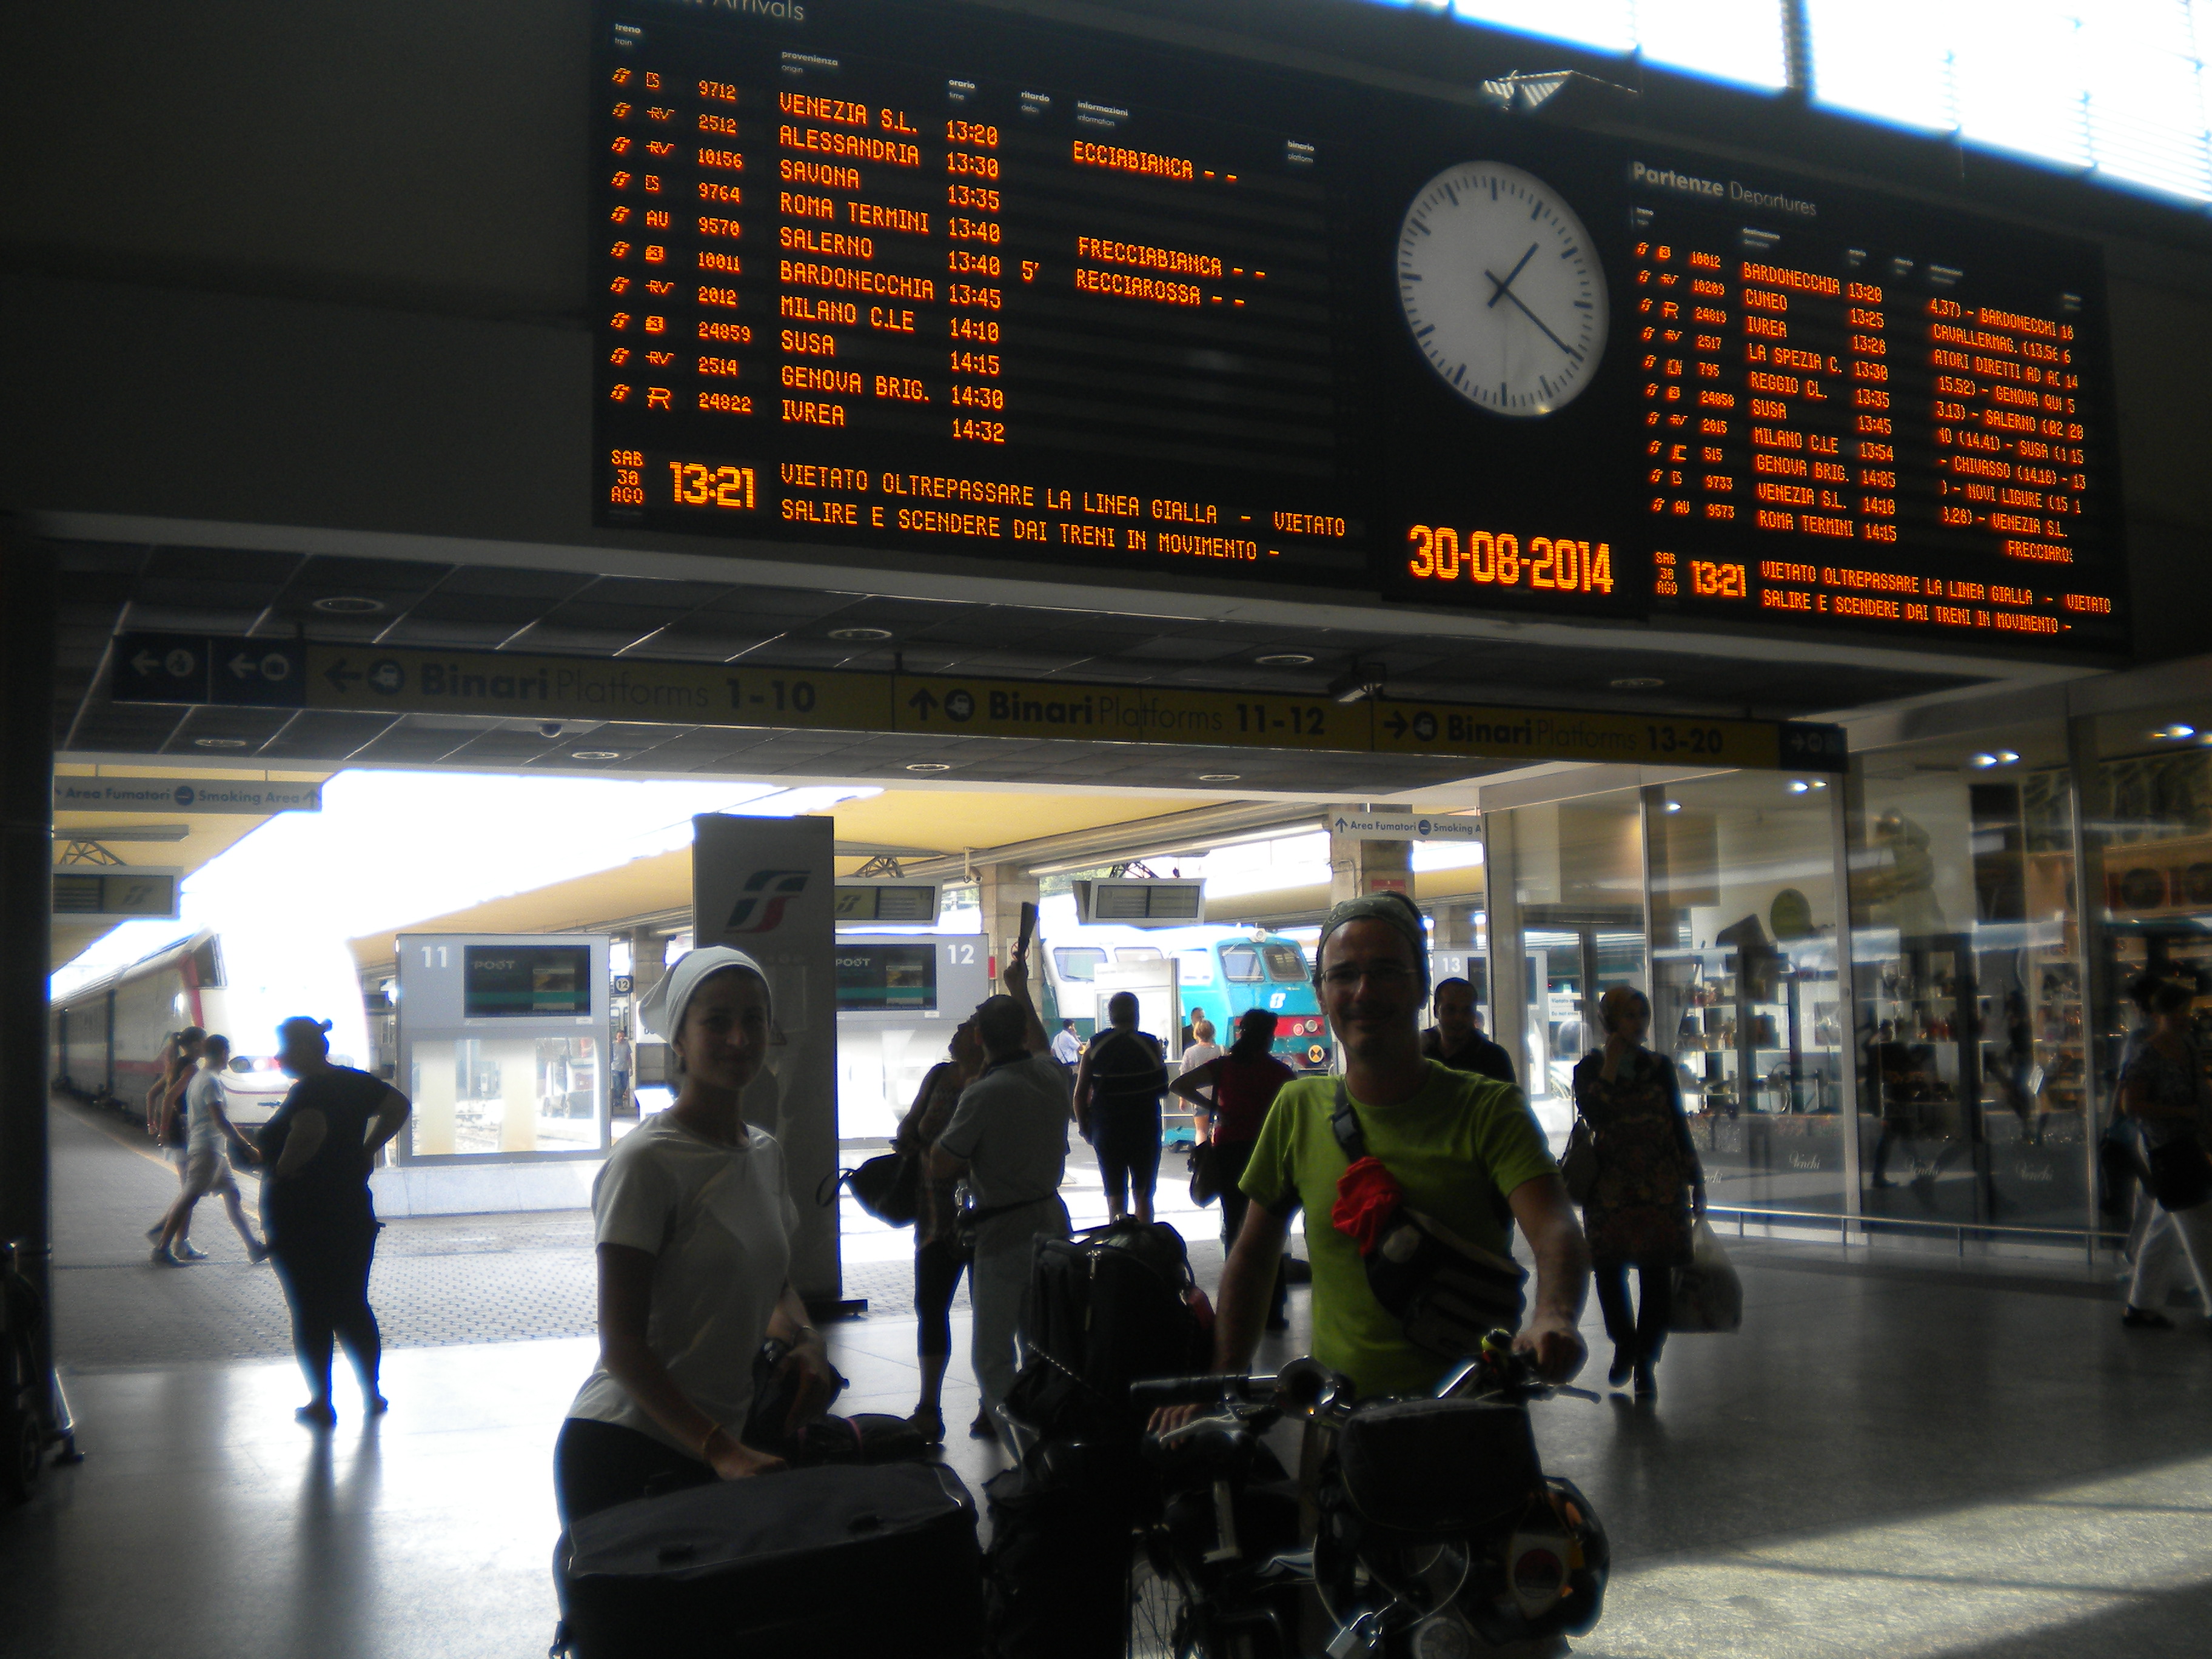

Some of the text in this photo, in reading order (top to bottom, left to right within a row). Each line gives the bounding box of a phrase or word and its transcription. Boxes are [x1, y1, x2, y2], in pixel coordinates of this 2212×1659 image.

[615, 23, 641, 34] treno
[782, 50, 838, 66] provenienza
[948, 79, 975, 89] orario
[1078, 100, 1128, 117] informazioni
[699, 81, 1193, 180] 9712 VENEZIA S.L. 13:20 ECCIABIANCA
[699, 115, 999, 180] 2512 ALESSANDRIA 13:30
[1288, 139, 1315, 152] binario
[699, 149, 1000, 212] 10156 SAVONA 13:35
[1634, 161, 1817, 216] Partenze Departures
[699, 183, 1222, 278] 9764 ROMA TERMINI 13:40 FRECCIABIANCA
[699, 217, 741, 238] 9570
[780, 227, 873, 260] SALERNO
[949, 250, 1000, 278] 13:40
[1076, 269, 1200, 306] RECCIAROSSA
[699, 252, 1001, 310] 10011 BARDONECCHIA 13:45
[1744, 261, 1840, 294] BARDONECCHIA
[1849, 283, 1882, 303] 13:20
[699, 286, 999, 344] 2012 MILANO C.LE 14:10
[1745, 288, 1788, 311] CUNEO
[1851, 307, 1885, 328] 13:25
[1933, 323, 2017, 354] CAVALLERMAG.
[699, 321, 1000, 377] 24859 SUSA 14:15
[1698, 335, 1721, 349] 2517
[1749, 343, 1766, 361] LA
[1774, 347, 1822, 369] SPEZIA
[1855, 361, 1888, 381] 13:30
[1996, 385, 2039, 407] GENOVA
[1748, 316, 2020, 379] IVREA ATORI DIRETTI
[699, 357, 1004, 411] 2514 GENOVA BRIG. 14:30
[1699, 362, 2036, 431] 795 REGGIO 13:35 SALERNO
[699, 392, 1005, 444] 24822 IVREA 14:32
[1752, 398, 2048, 458] SUSA 13:45 SUSA
[612, 449, 644, 468] SAB
[1703, 418, 1728, 434] 2015
[1755, 427, 1802, 448] MILANO
[1860, 442, 1894, 461] 13:54
[1954, 455, 2011, 478] CHIVASSO
[611, 487, 644, 504] AGO
[617, 469, 638, 487] 30
[670, 462, 756, 509] 13:21
[782, 463, 1344, 537] VIETATO OLTREPASSARE LA LINEA GIALLA VIETATO
[1704, 447, 2042, 508] 515 GENOVA BRIG. 14:05 NOVI LIGURE
[782, 499, 1256, 560] SALIRE E SCENDERE DAI TRENI IN MOVIMENTO
[1706, 475, 2040, 534] 9733 VENEZIA S.L. 14:10 VENEZIA
[1708, 504, 1897, 541] 9573 ROMA TERMINI 14:15
[1409, 525, 1614, 594] 30-08-2014
[1691, 560, 1746, 597] 13:21
[1657, 580, 1677, 595] AGO
[1762, 561, 2111, 613] VIETATO OLTREPASSARE LA LINEA GIALLA VIETATO
[1763, 589, 2058, 633] SALIRE E SCENDERE DAI TRENI IN MOVIMENTO
[421, 663, 816, 712] Binari Platforms 1-10
[990, 690, 1326, 736] Binari Platforms 11-12
[1447, 714, 1723, 754] Binari Platforms 13-20
[65, 788, 300, 805] Area Fumatori Smoking Area
[1351, 822, 1473, 836] Area Fumatori Smoking
[421, 946, 448, 968] 11
[948, 944, 974, 964] 12
[1443, 957, 1461, 973] 13
[617, 979, 629, 990] 12
